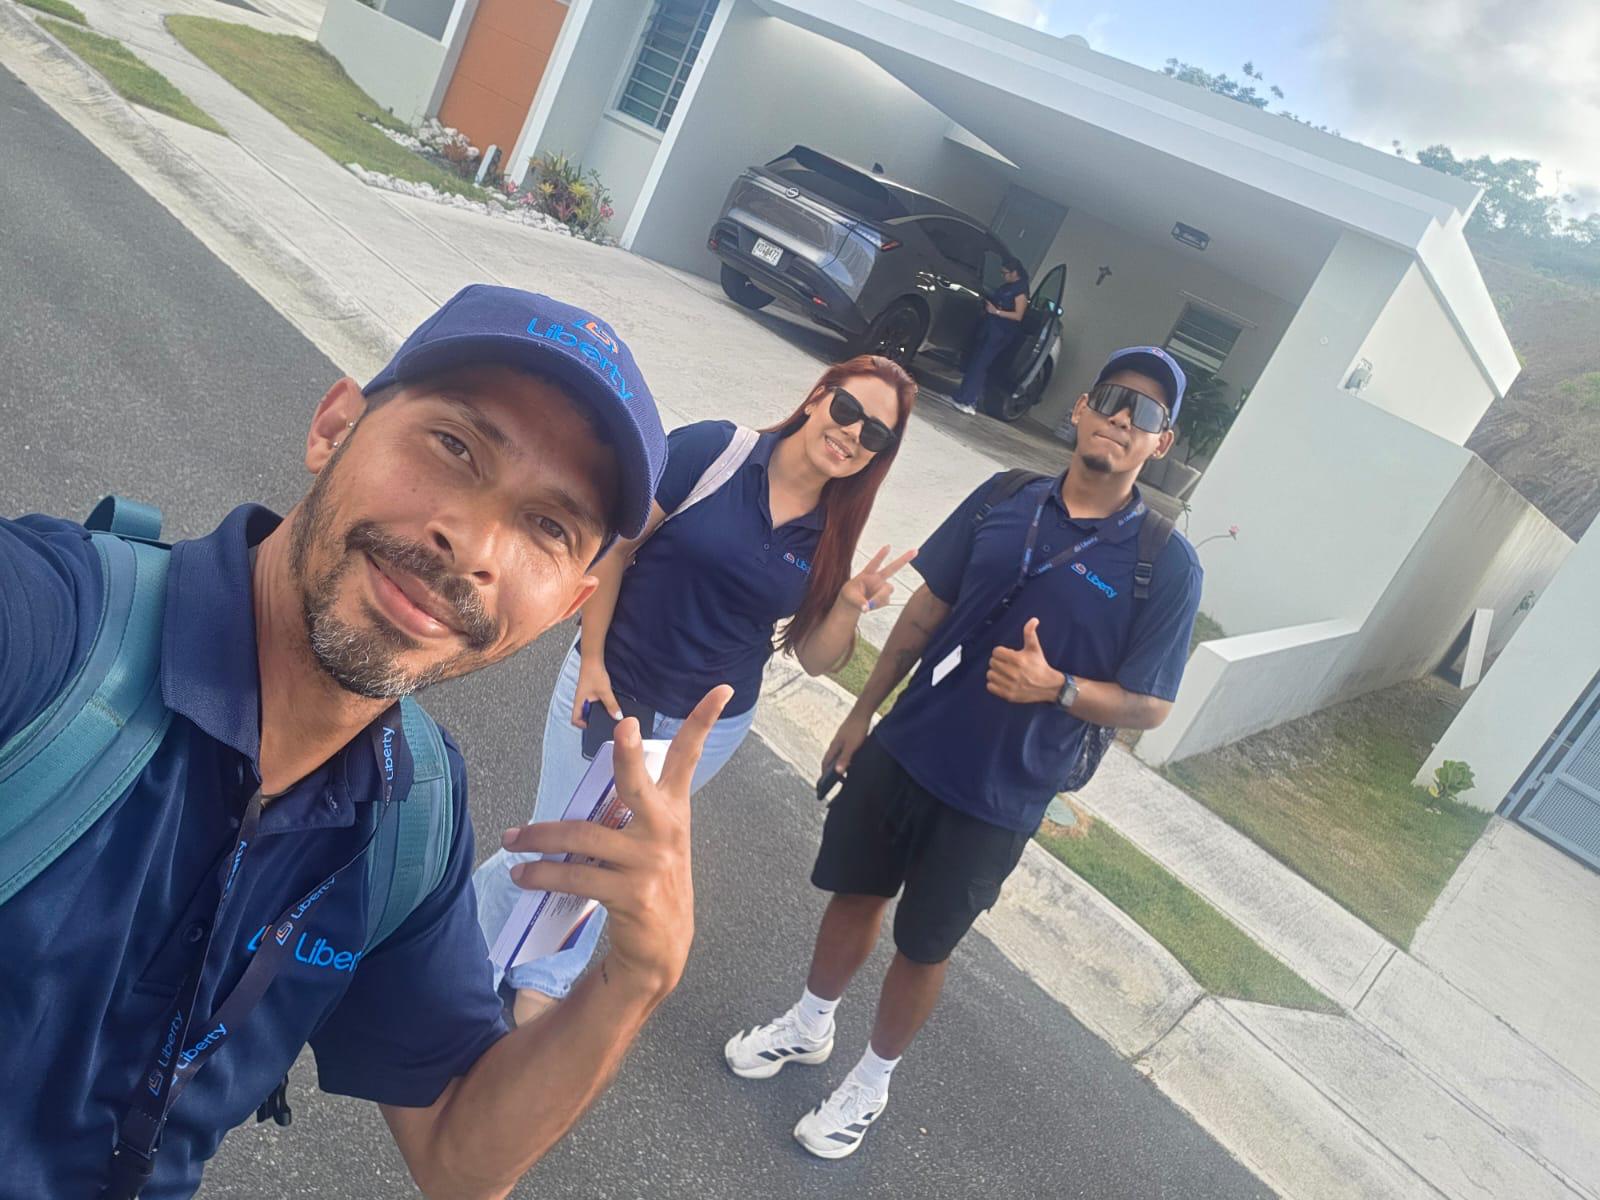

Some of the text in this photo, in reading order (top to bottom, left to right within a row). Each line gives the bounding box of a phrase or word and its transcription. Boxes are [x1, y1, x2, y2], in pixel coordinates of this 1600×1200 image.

[526, 317, 633, 400] Liberty
[1085, 570, 1118, 598] Liberty
[383, 726, 396, 781] Liberty
[290, 876, 335, 919] Liberty
[158, 1009, 183, 1068] Liberty
[176, 1023, 228, 1070] Liberty
